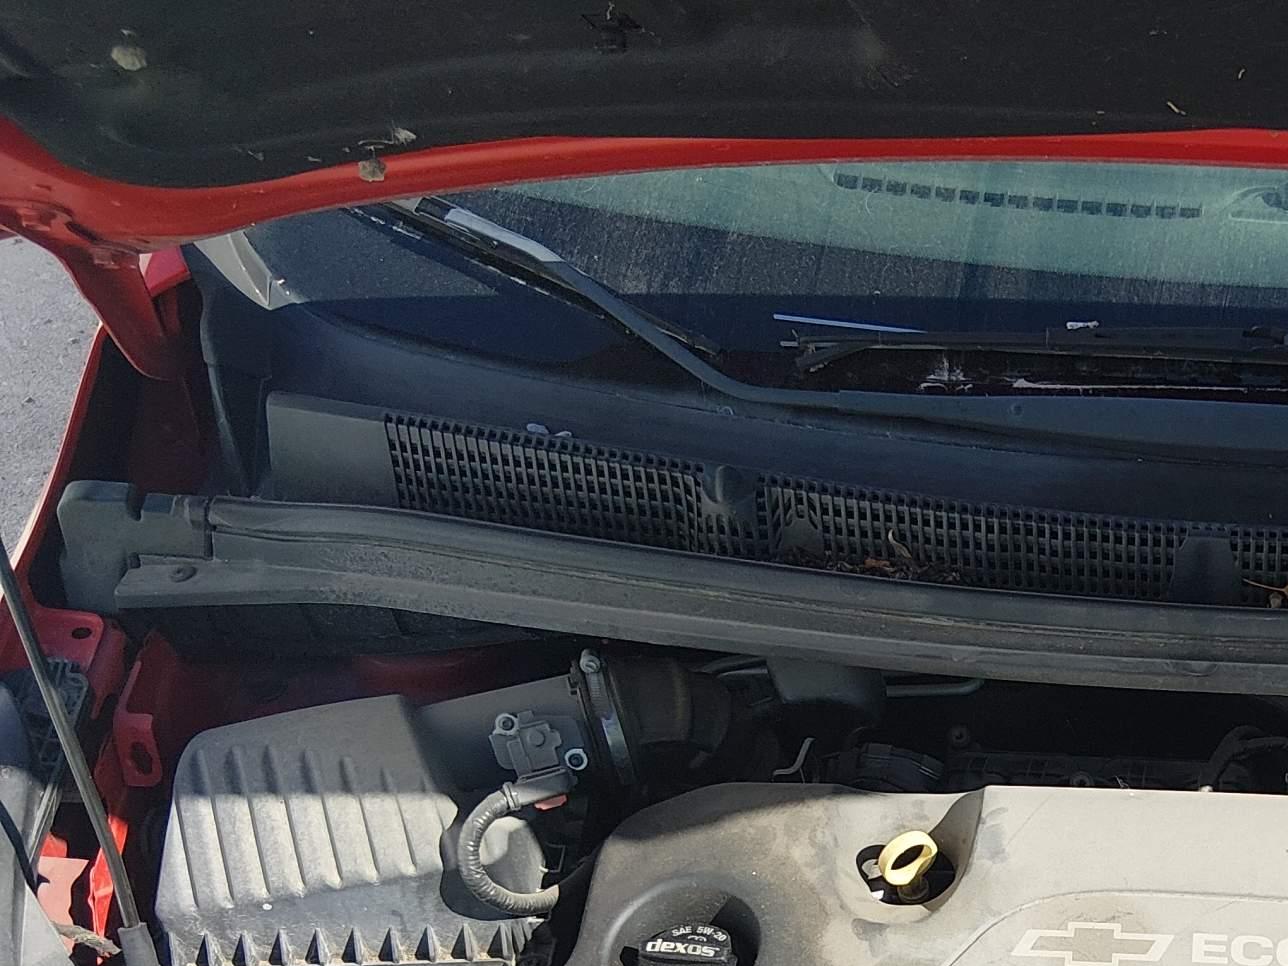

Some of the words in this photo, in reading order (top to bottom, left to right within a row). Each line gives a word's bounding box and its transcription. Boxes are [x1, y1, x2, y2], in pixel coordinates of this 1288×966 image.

[672, 926, 692, 936] SAE
[697, 926, 727, 941] 5W-20
[646, 939, 720, 957] dexos
